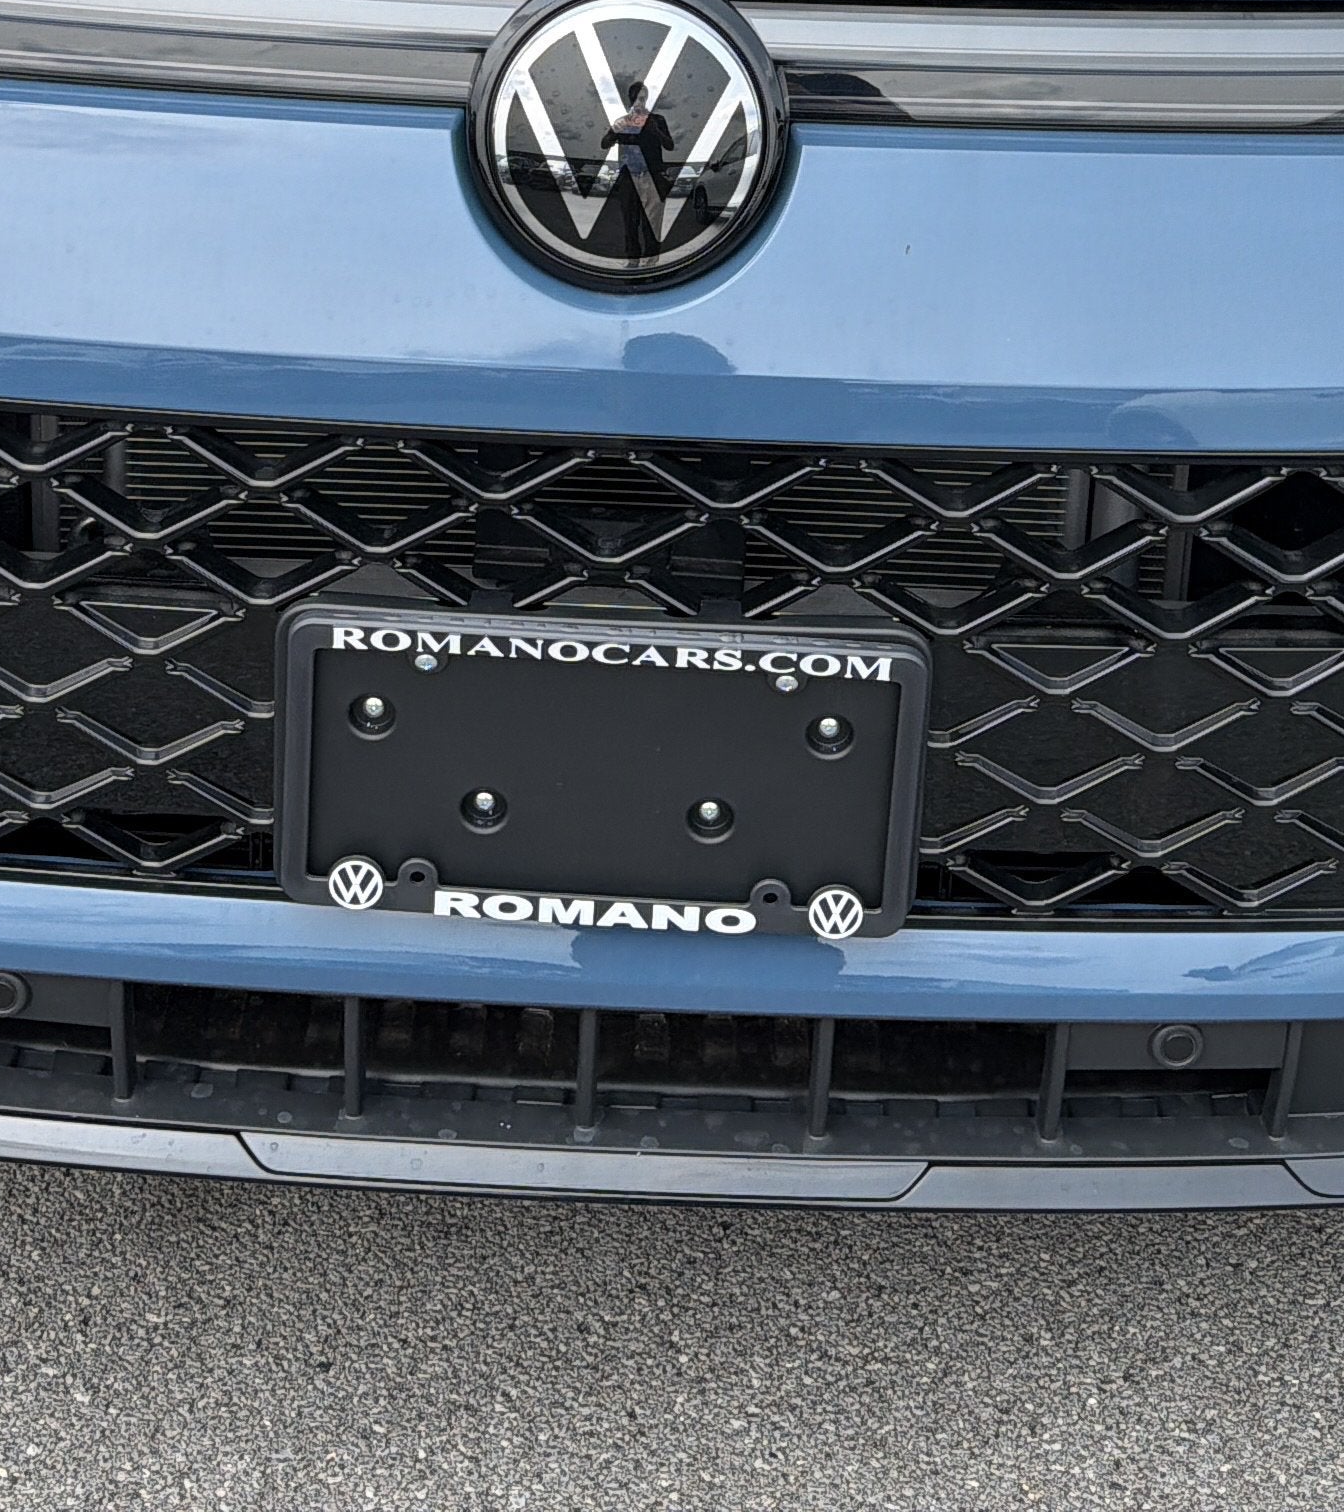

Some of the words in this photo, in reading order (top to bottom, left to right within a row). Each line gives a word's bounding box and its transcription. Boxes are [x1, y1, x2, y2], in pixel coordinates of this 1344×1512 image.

[331, 626, 893, 682] ROMANOCARS.COM
[328, 860, 384, 911] VW
[433, 889, 757, 934] ROMANO
[808, 888, 864, 940] VW
